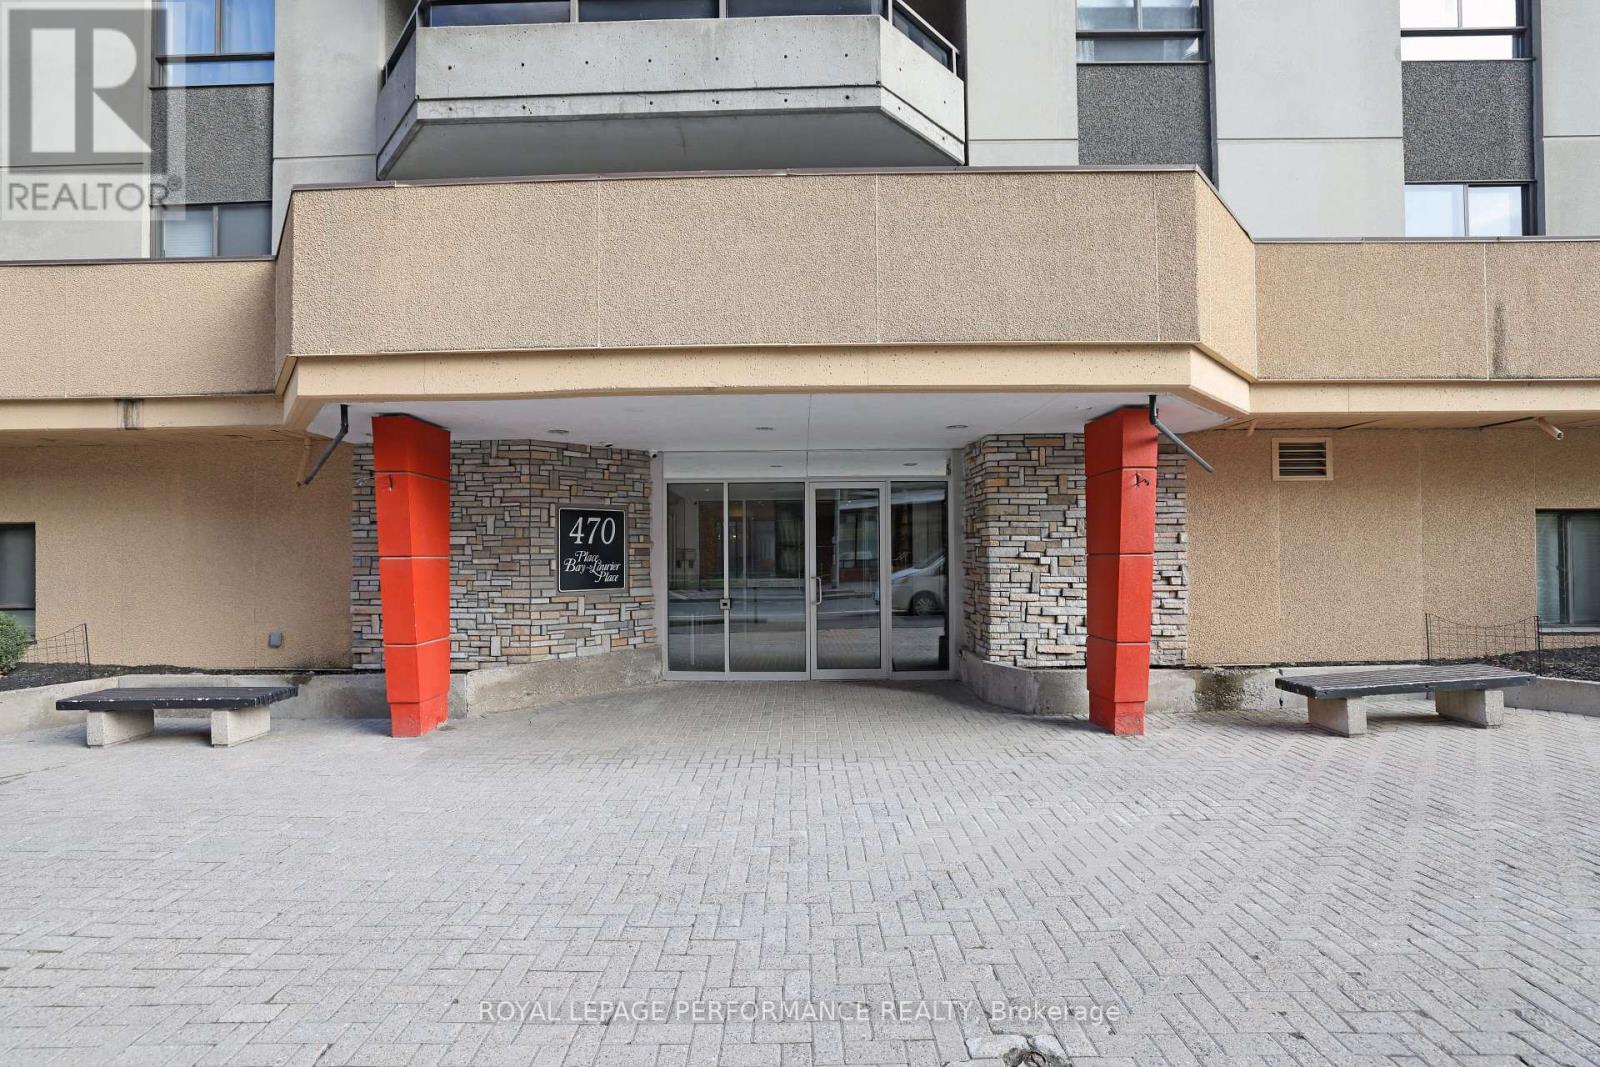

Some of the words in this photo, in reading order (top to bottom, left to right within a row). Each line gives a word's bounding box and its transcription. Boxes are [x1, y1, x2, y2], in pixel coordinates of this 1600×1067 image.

[569, 517, 616, 545] 470
[575, 550, 599, 563] Place
[563, 558, 586, 574] Bay
[594, 571, 619, 583] Place
